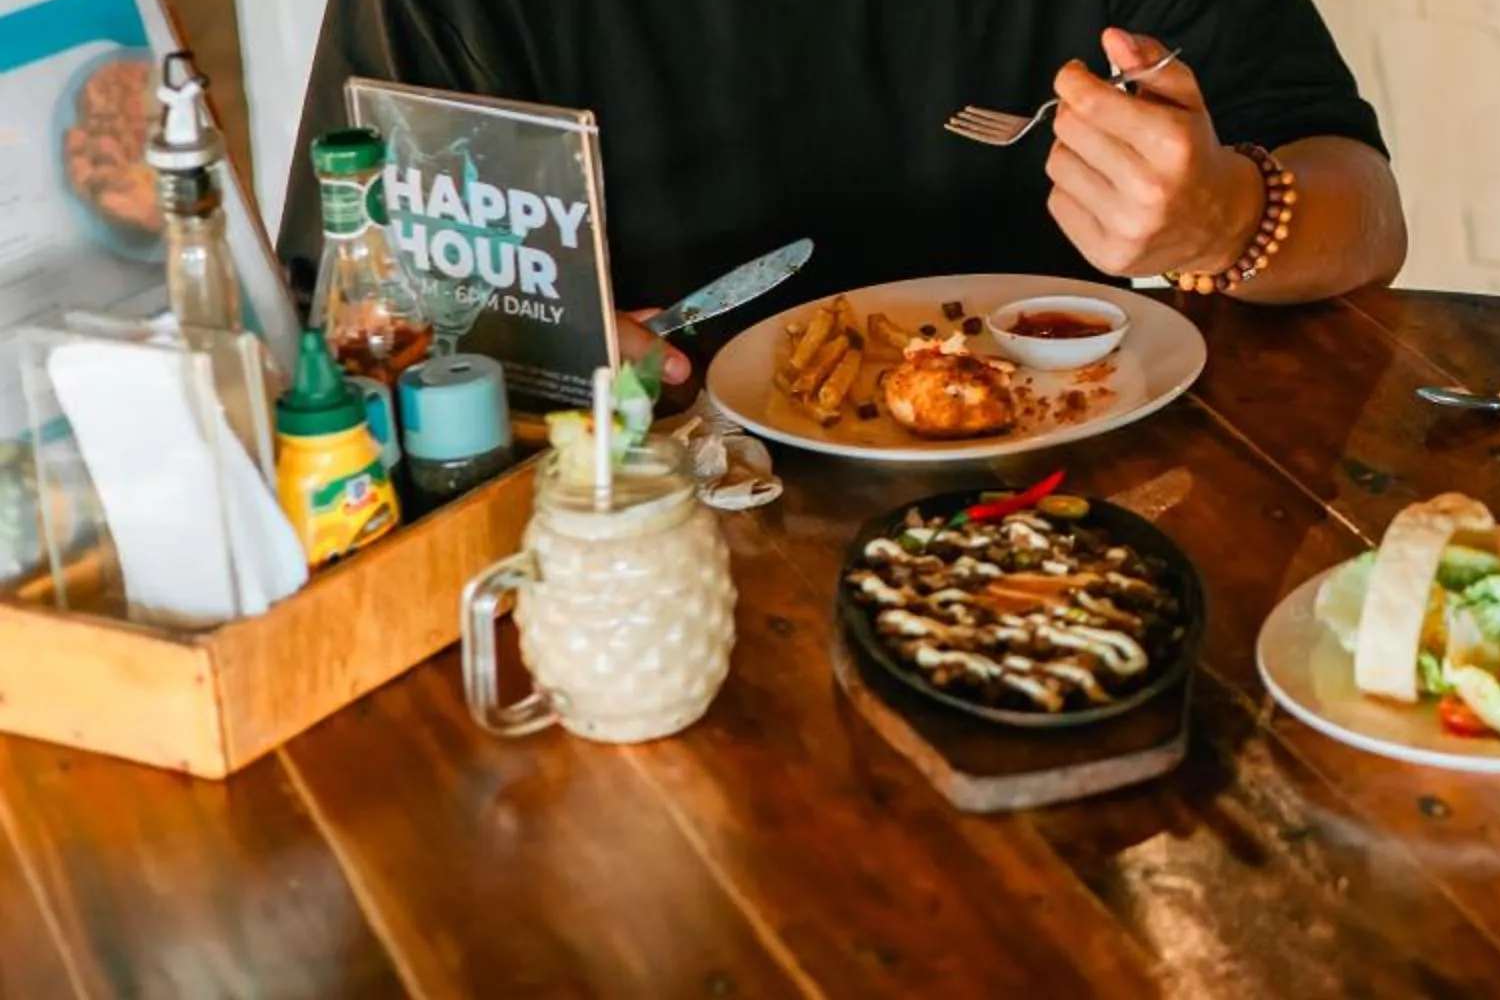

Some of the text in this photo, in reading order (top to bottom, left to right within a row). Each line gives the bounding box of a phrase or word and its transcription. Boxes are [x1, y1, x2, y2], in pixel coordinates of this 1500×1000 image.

[383, 164, 588, 248] HAPPY
[393, 219, 560, 298] HOUR
[504, 296, 564, 325] DAILY
